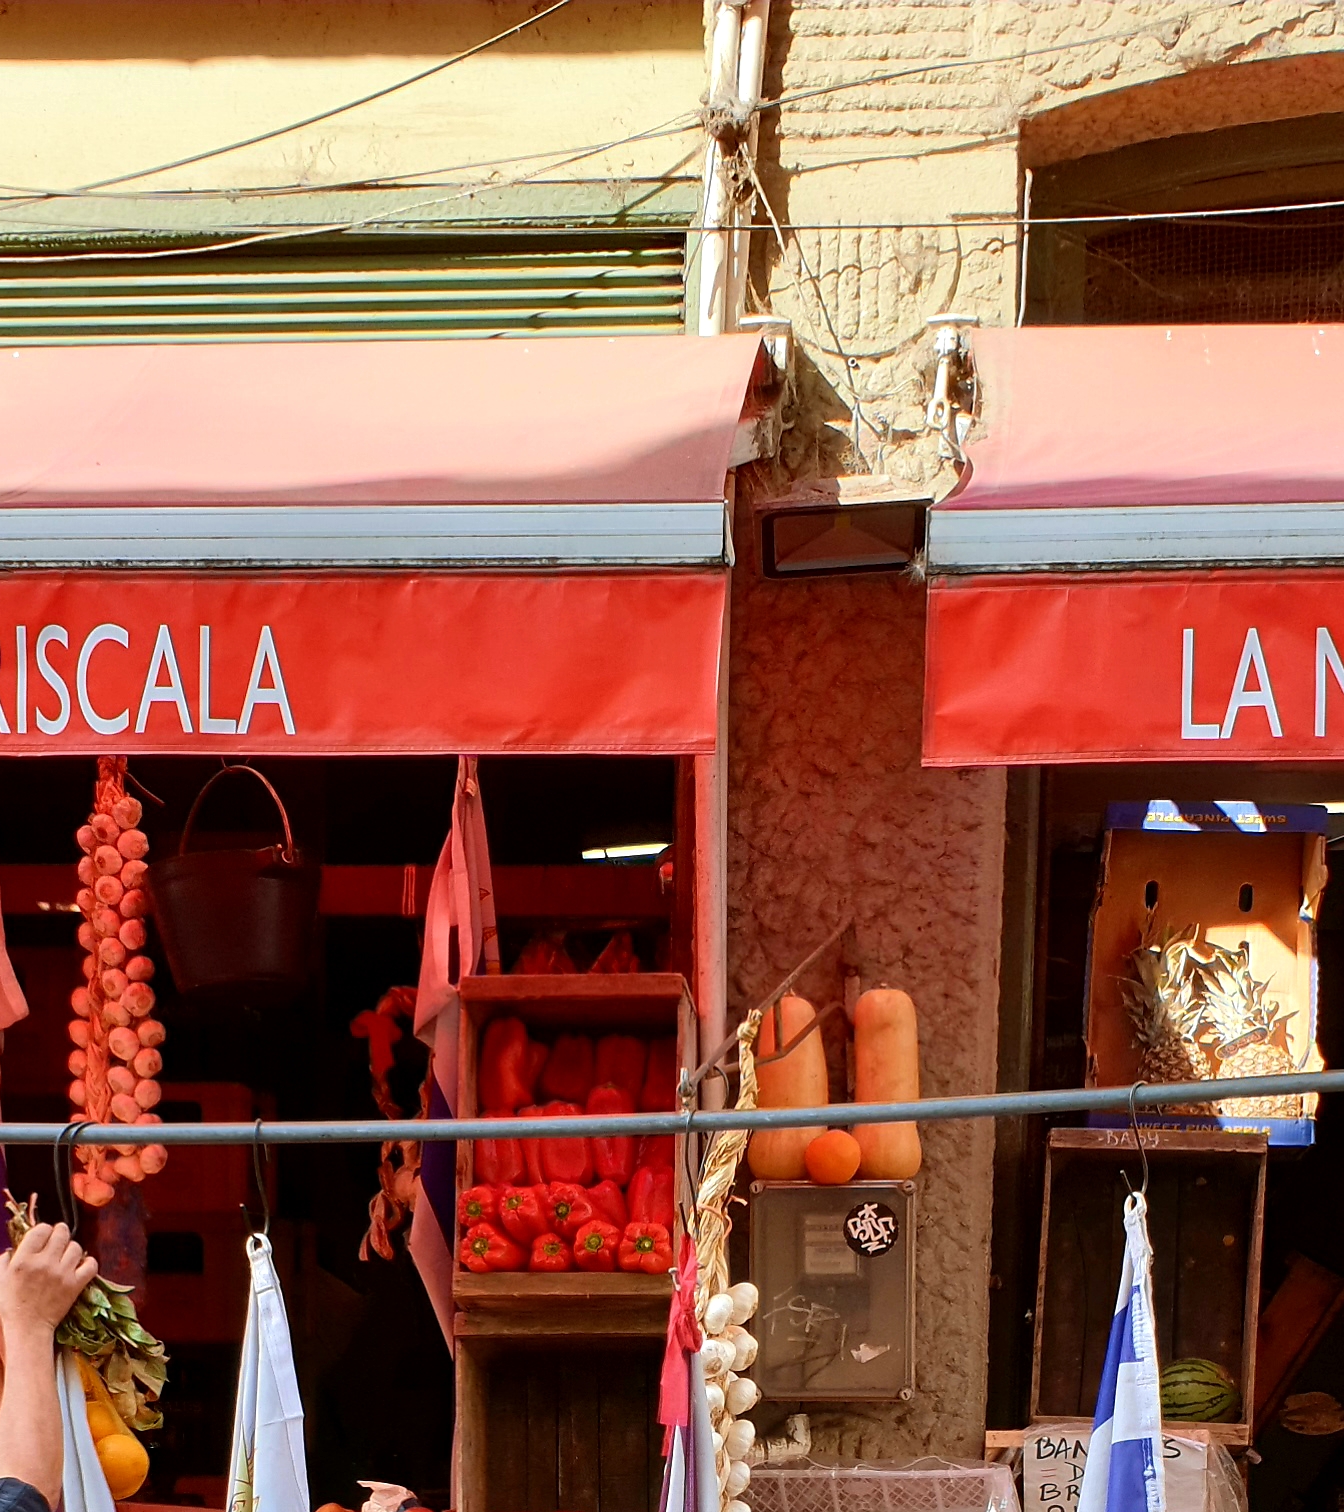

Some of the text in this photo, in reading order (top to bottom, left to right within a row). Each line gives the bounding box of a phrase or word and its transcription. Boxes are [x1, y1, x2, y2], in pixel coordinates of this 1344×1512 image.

[1181, 627, 1283, 740] LA
[1146, 812, 1287, 825] SWEET PINEAPPLE
